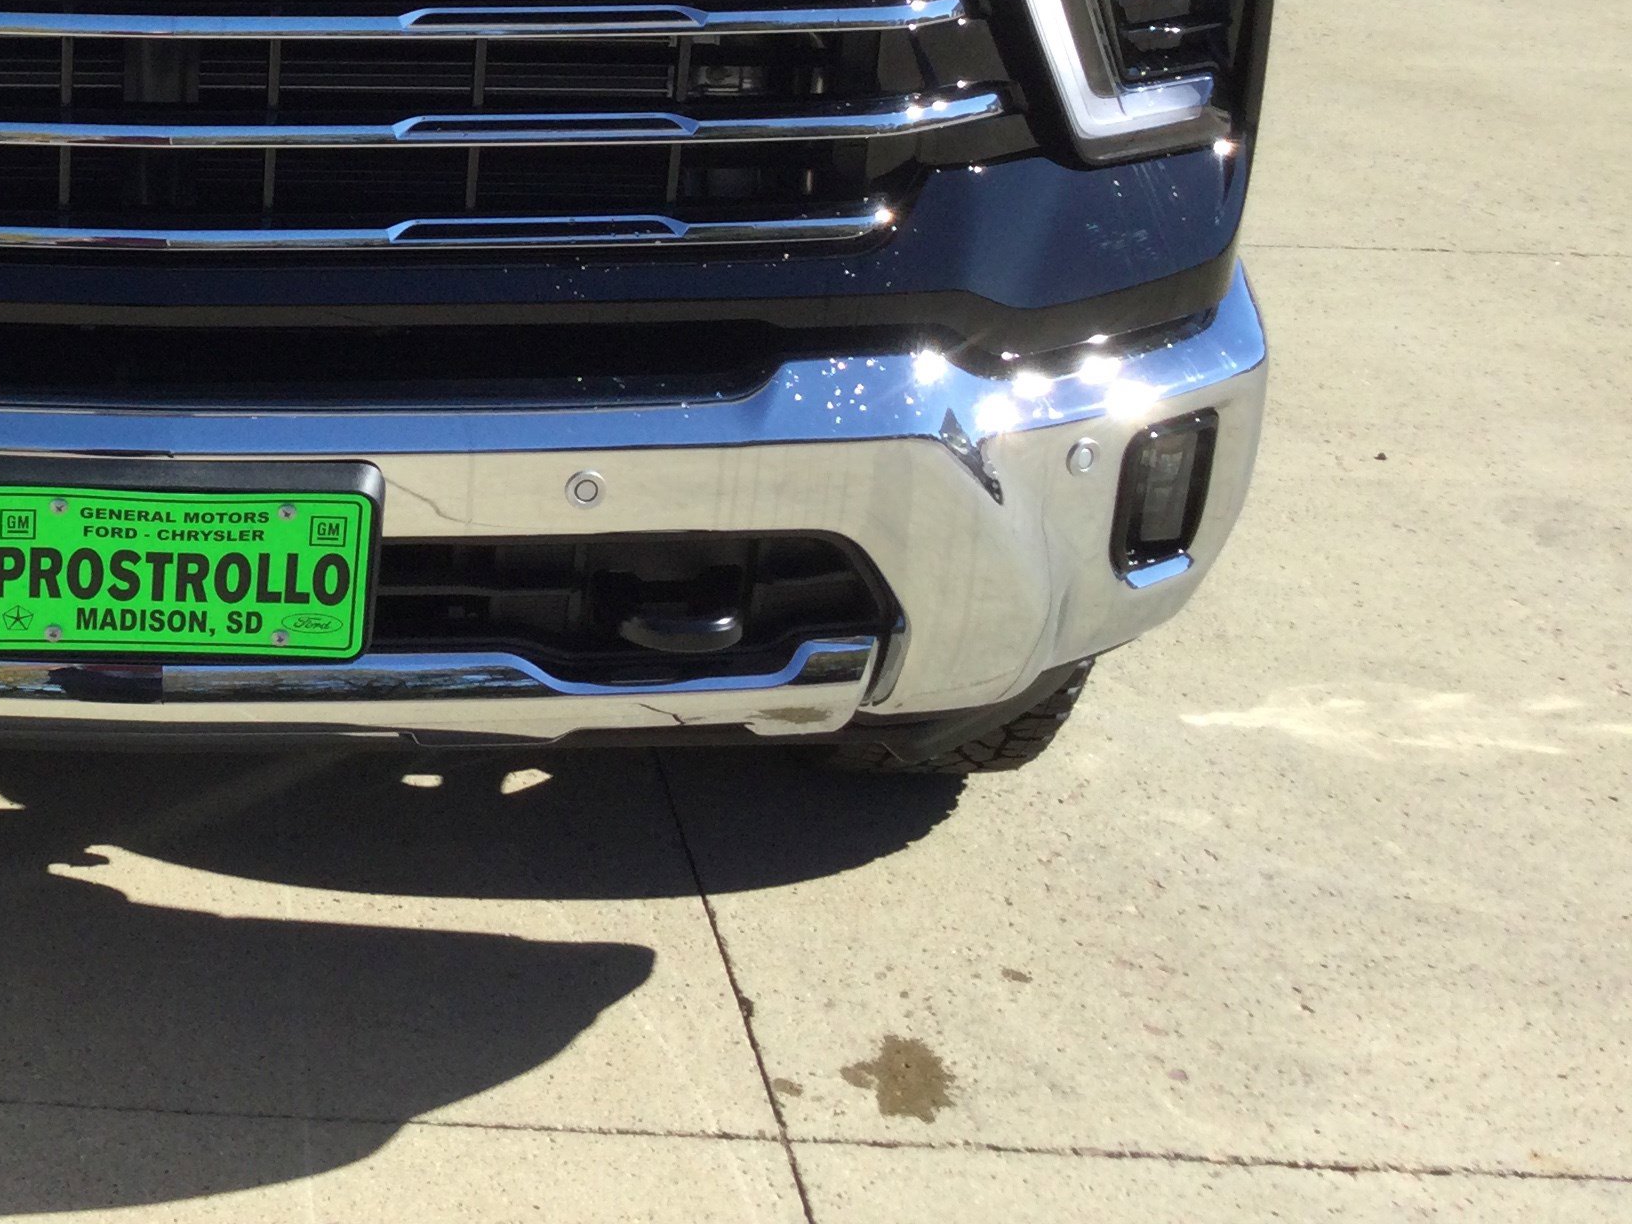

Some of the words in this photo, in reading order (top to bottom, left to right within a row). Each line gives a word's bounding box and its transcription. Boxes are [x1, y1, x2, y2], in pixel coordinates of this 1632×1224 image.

[7, 515, 29, 529] GM
[80, 507, 176, 523] GENERAL
[183, 512, 269, 524] MOTORS
[83, 526, 138, 539] FORD
[157, 529, 265, 542] CHRYSLER
[317, 522, 340, 537] GM
[76, 607, 216, 637] MADISON,
[226, 611, 263, 634] SD
[293, 616, 332, 630] Ford
